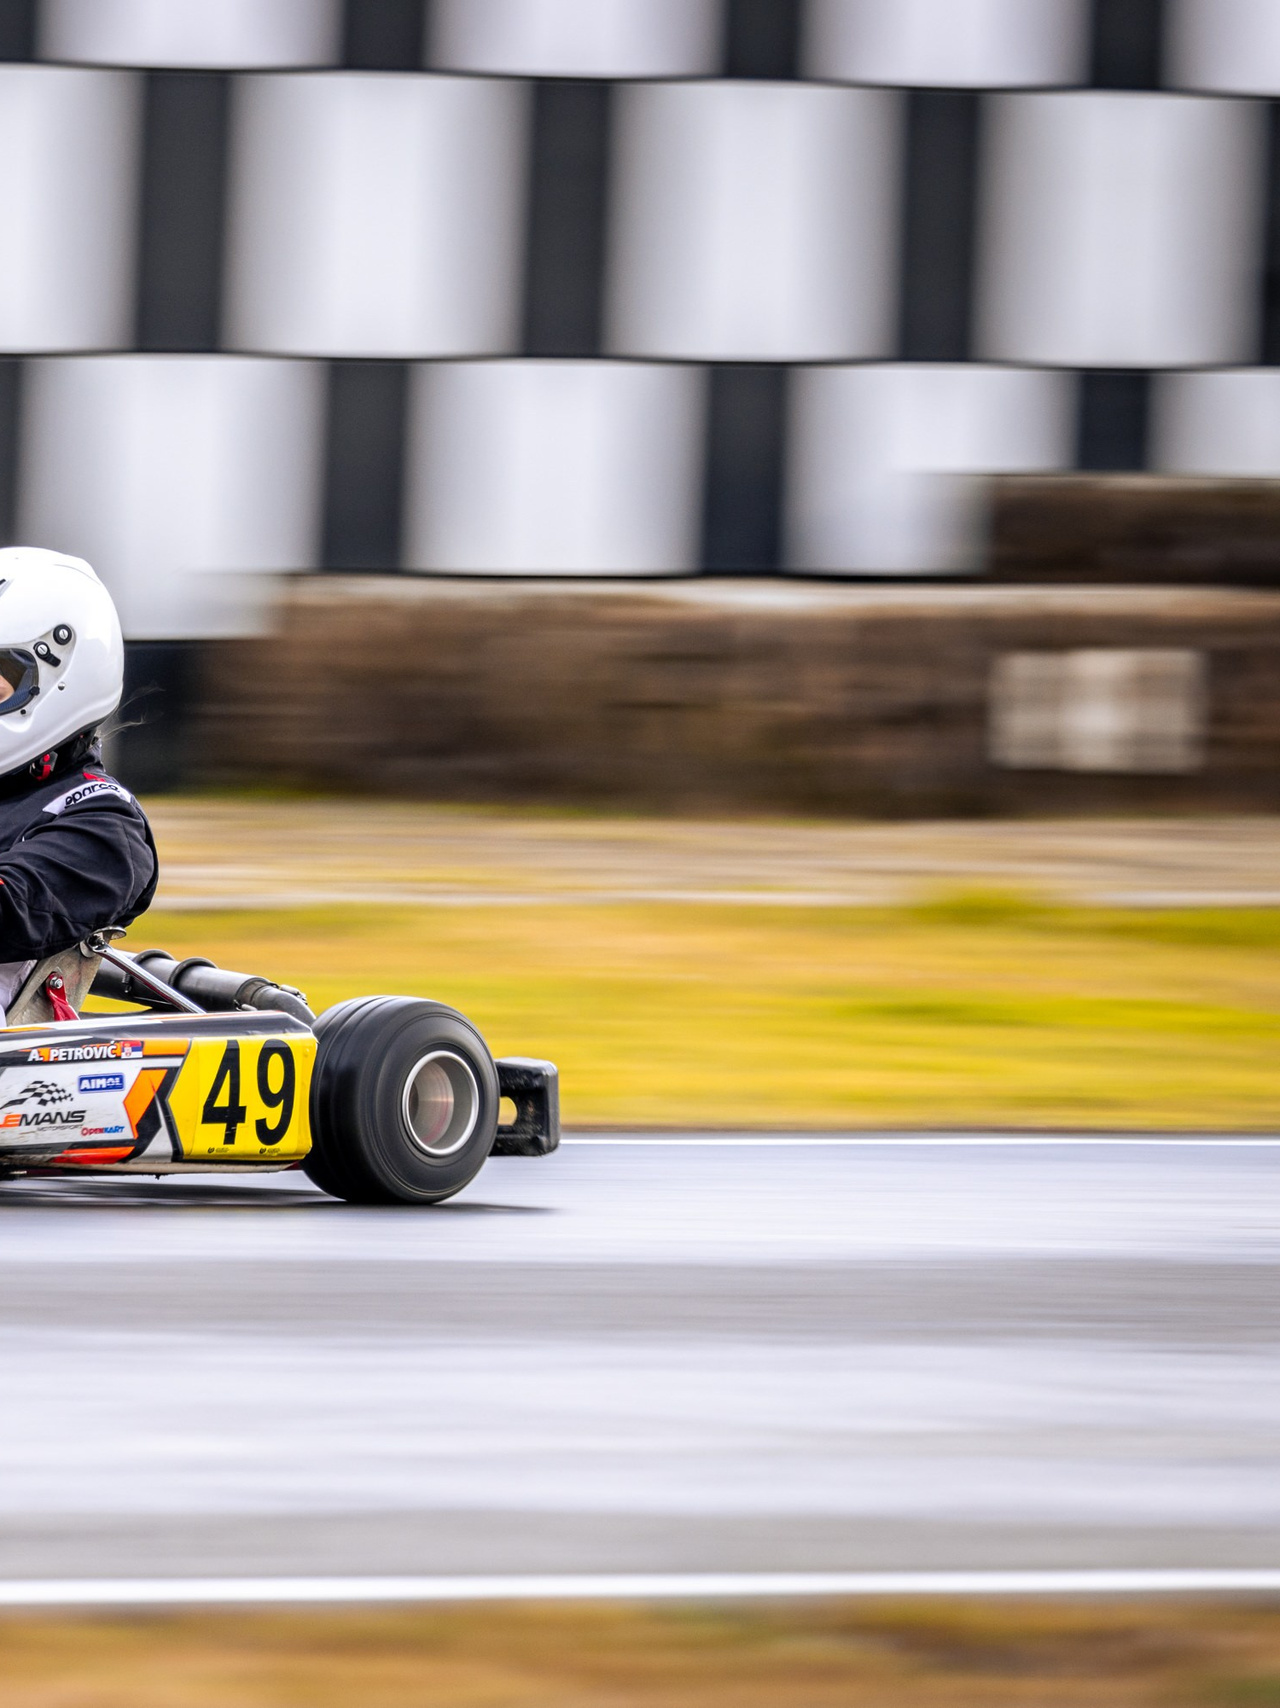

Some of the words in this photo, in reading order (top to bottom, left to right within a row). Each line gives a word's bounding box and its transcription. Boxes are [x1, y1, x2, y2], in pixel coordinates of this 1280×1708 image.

[64, 783, 120, 809] sparco
[28, 1049, 44, 1061] A.
[49, 1041, 117, 1061] PETROVIĆ
[201, 1039, 296, 1146] 49
